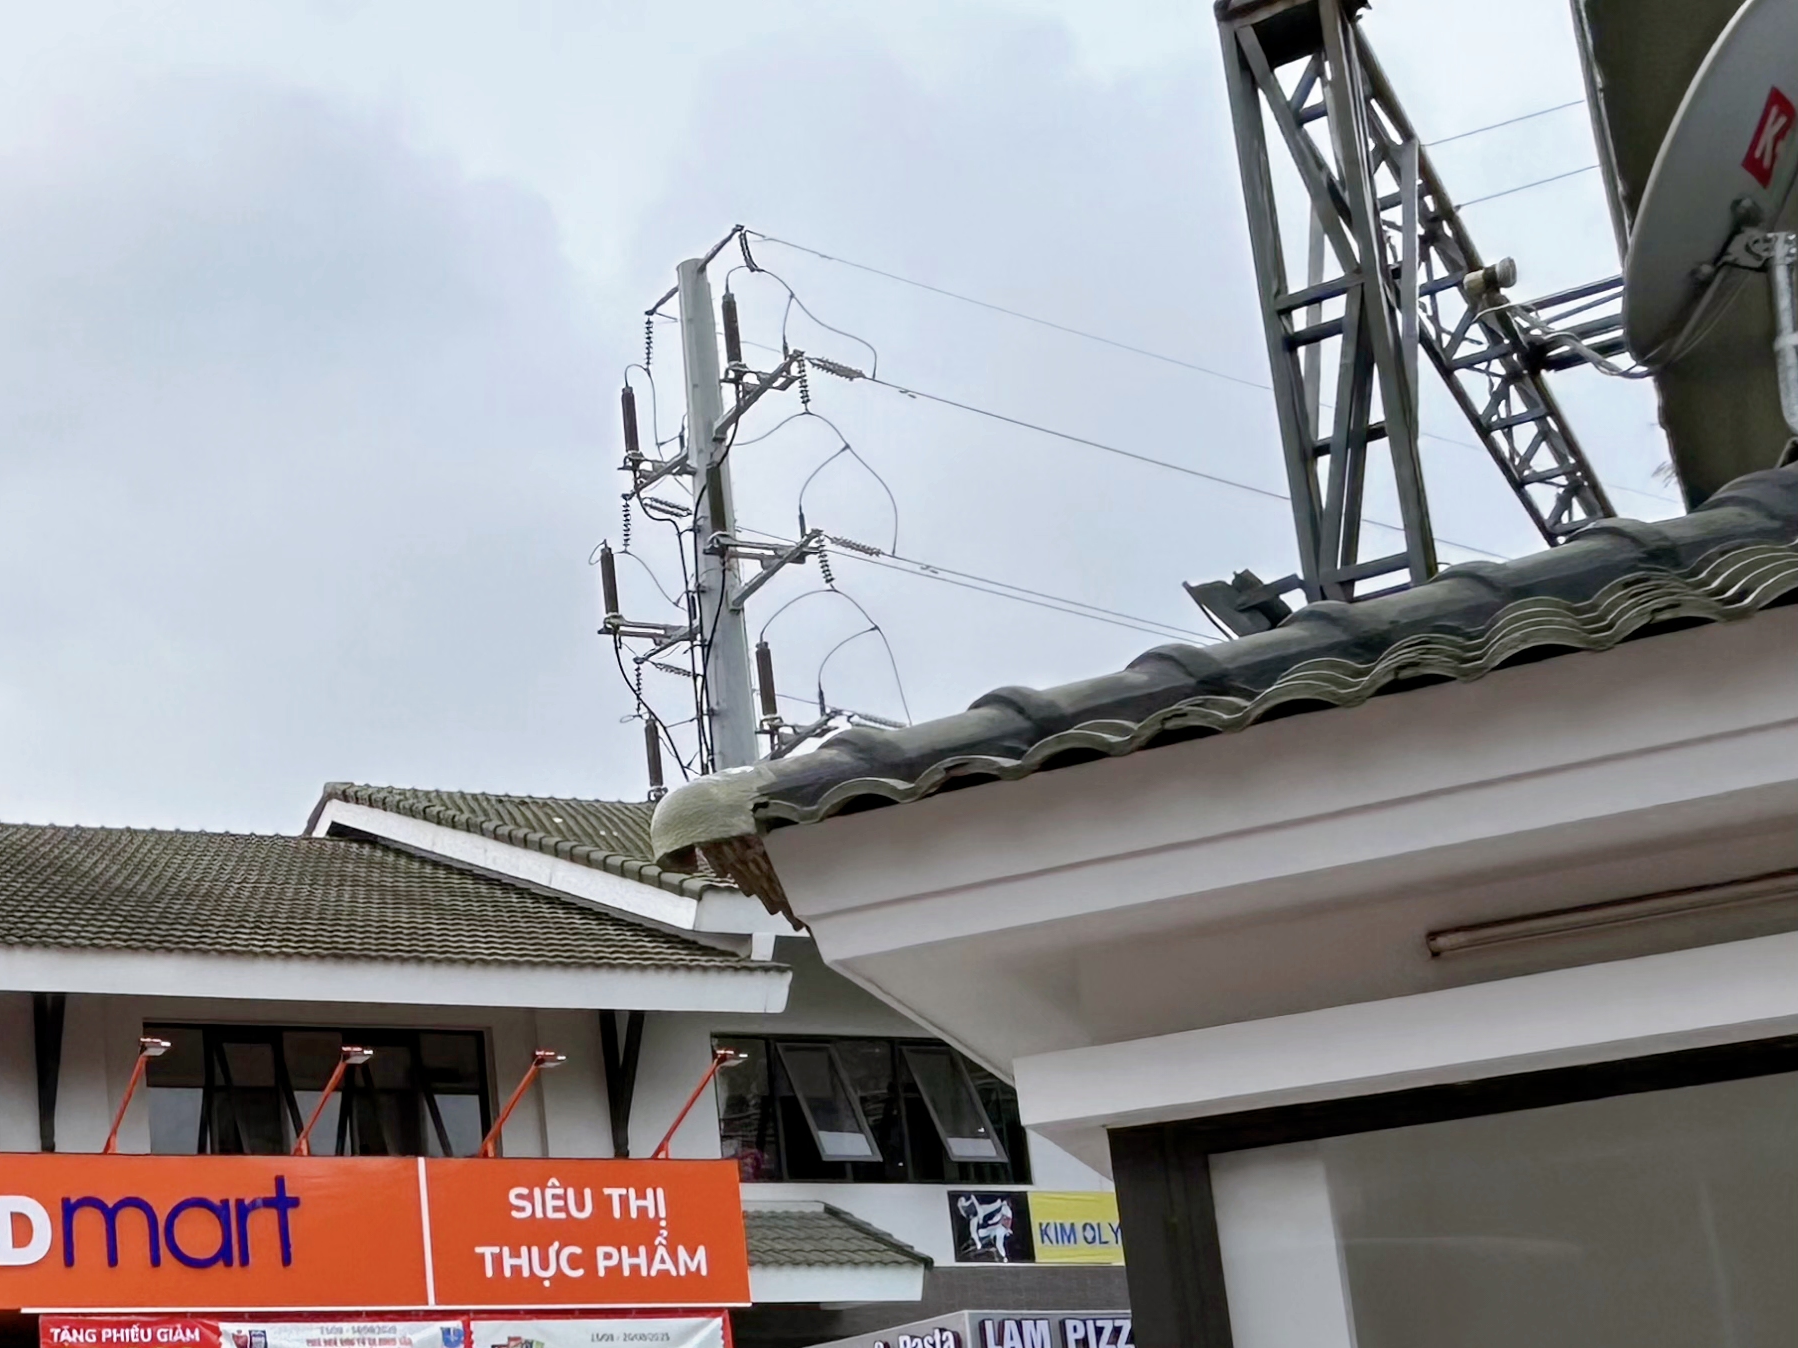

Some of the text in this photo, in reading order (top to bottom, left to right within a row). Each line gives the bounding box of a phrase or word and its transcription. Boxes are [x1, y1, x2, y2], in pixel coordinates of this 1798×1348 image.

[509, 1177, 667, 1228] SIÊU THỊ
[1038, 1222, 1078, 1245] KIM
[475, 1229, 709, 1287] THỰC PHẨM
[49, 1322, 201, 1347] TẶNG PHIẾU GIẢM
